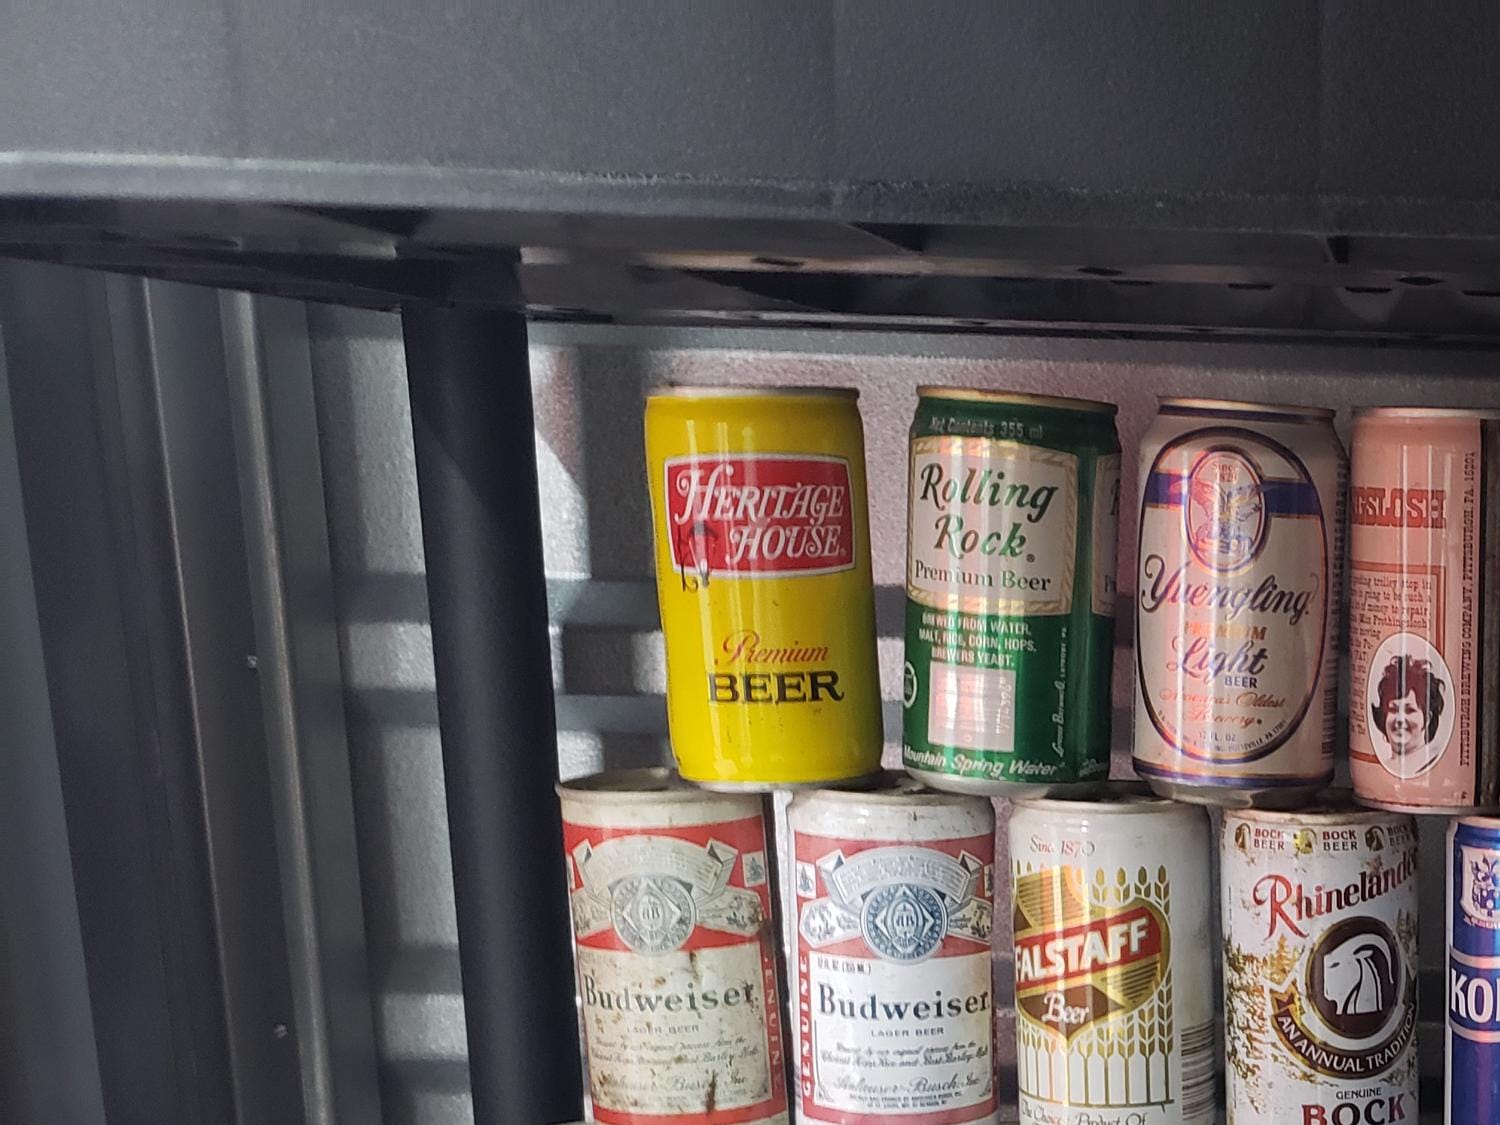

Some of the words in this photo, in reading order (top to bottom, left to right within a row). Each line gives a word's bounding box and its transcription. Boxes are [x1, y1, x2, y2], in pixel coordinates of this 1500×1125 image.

[920, 463, 1060, 523] Rolling
[725, 520, 842, 562] HOUSE
[934, 514, 1026, 559] Rock
[915, 560, 993, 587] Premium
[1002, 570, 1051, 591] Beer
[1141, 554, 1309, 626] Yuengling
[957, 614, 987, 632] FROM
[715, 630, 828, 665] Premium
[1167, 636, 1268, 684] Light
[708, 670, 845, 703] BEER
[1225, 676, 1257, 688] BEER
[1460, 642, 1472, 697] BREWING
[904, 745, 947, 767] Mountain
[951, 753, 1004, 778] Spring
[1009, 760, 1057, 775] Water
[1253, 838, 1286, 852] BEER
[1323, 840, 1359, 852] BEER
[1322, 829, 1357, 842] BOCK
[1015, 916, 1151, 984] FALSTAFF
[583, 974, 752, 1013] Budweiser
[819, 982, 990, 1020] Budweiser
[1043, 990, 1090, 1026] Beer
[871, 1028, 910, 1037] LAGER
[916, 1027, 944, 1036] BEER
[1279, 1014, 1299, 1044] AN
[1295, 1041, 1365, 1074] ANNUAL
[1364, 1004, 1419, 1072] TRADITION
[1335, 1085, 1383, 1101] GENUINE
